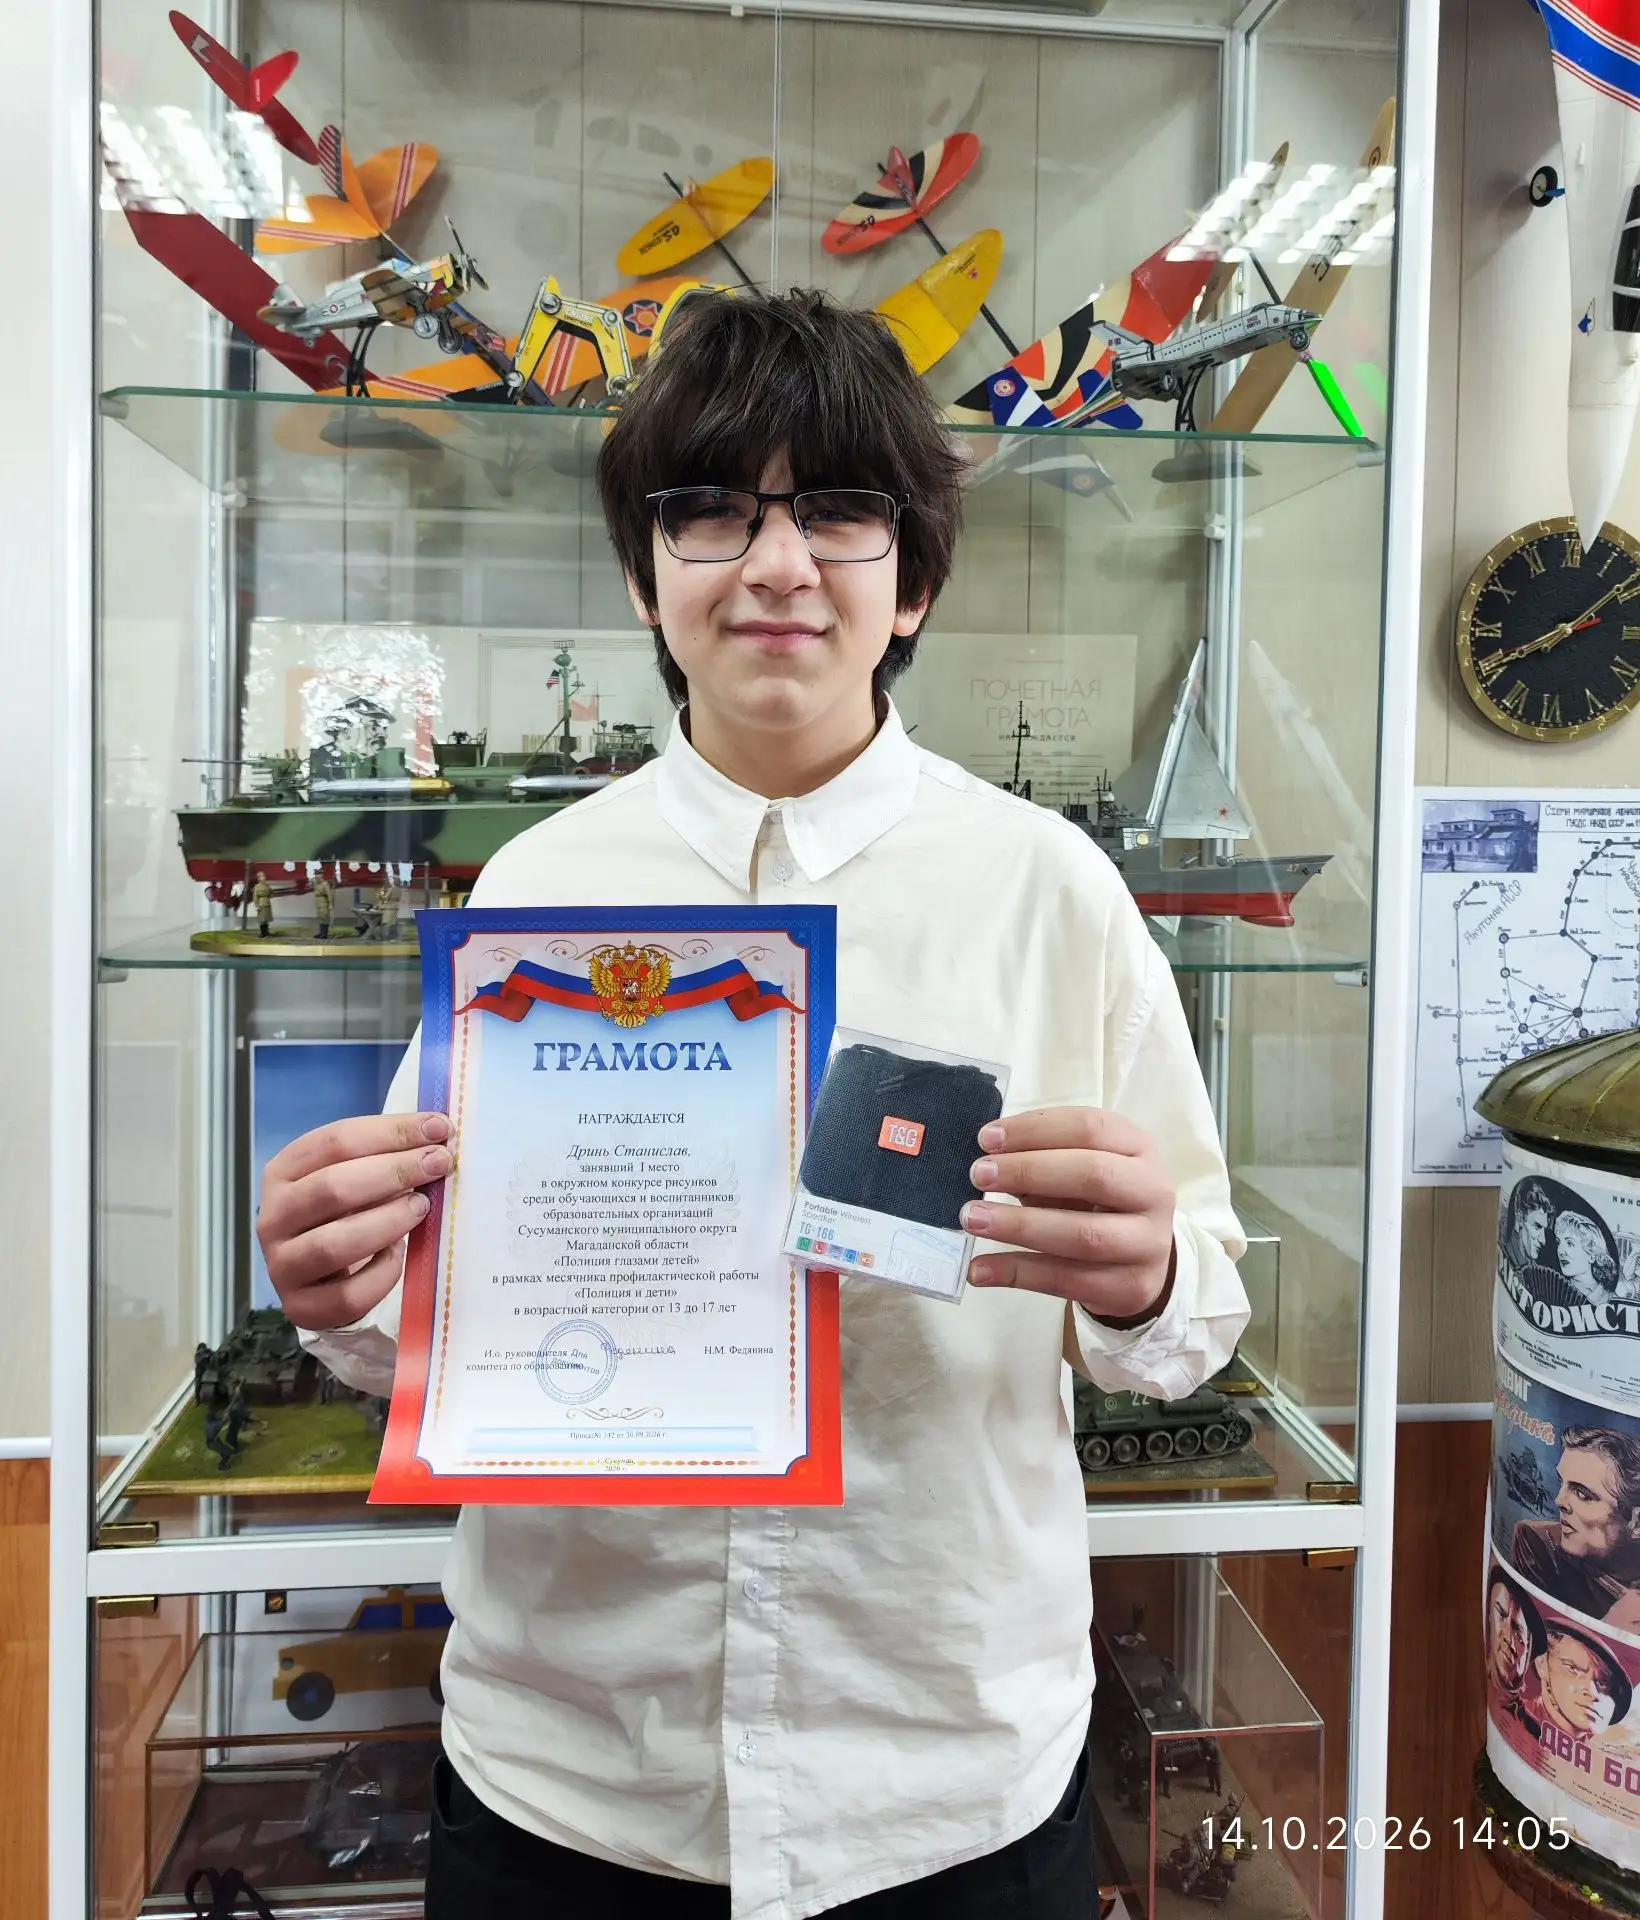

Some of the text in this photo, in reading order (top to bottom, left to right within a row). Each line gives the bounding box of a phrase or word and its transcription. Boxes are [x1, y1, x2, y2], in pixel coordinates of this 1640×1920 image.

[970, 678, 1101, 700] ПОЧЕТНАЯ
[985, 707, 1091, 728] ГРАМОТА
[532, 1041, 732, 1072] ГРАМОТА
[578, 1113, 685, 1125] НАГРАЖДАЕТСЯ
[888, 1123, 918, 1148] T&G
[566, 1144, 691, 1161] Дринь Станислав,
[579, 1162, 634, 1174] занявший
[648, 1164, 680, 1172] место
[541, 1178, 717, 1191] в окружном конкурсе рисунков
[522, 1193, 734, 1206] среди обучающихся и воспитанников
[543, 1208, 713, 1221] образовательных организаций
[804, 1200, 838, 1216] Portable
[801, 1209, 836, 1224] Speaker
[518, 1224, 737, 1237] Сусуманского муниципального округа
[799, 1221, 835, 1241] TG-166
[566, 1239, 688, 1252] Магаданской области
[554, 1255, 699, 1267] «Полиция глазами детей»
[492, 1271, 759, 1285] в рамках месячника профилактической работы
[575, 1288, 677, 1300] «Полиция и дети»
[514, 1303, 736, 1316] в возрастной категории от 13 до 17 лет
[484, 1345, 774, 1360] И.о. руководителя Н.М. Федянина
[466, 1363, 507, 1372] комитета
[510, 1364, 521, 1372] по
[1538, 1720, 1592, 1775] ДВА
